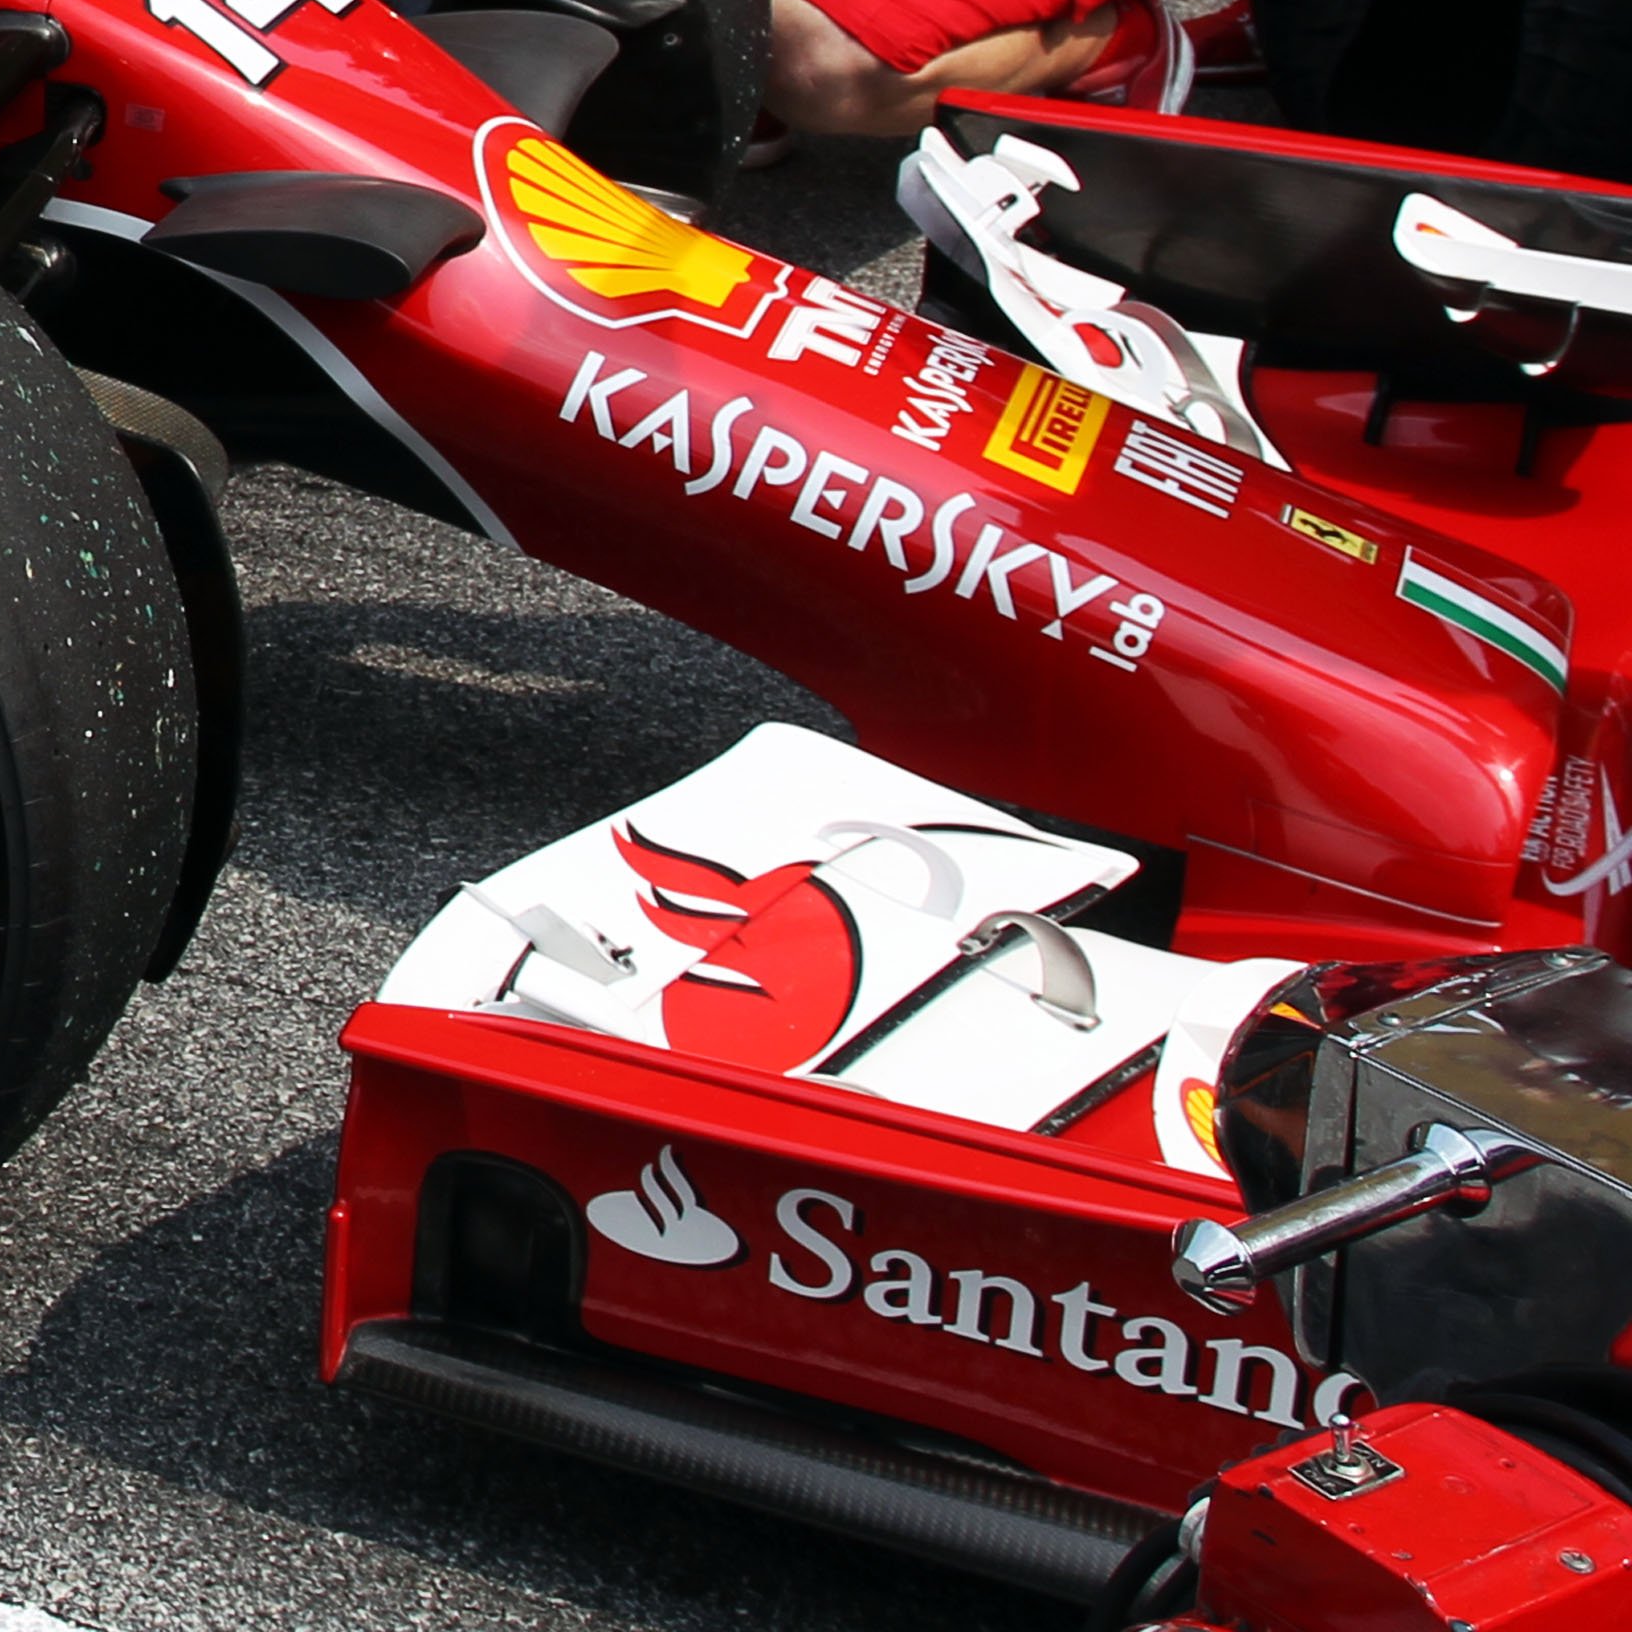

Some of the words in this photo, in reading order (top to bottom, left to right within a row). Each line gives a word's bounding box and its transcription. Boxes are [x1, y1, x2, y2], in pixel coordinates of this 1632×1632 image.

[767, 275, 887, 368] TNT
[890, 328, 996, 451] KASPERSK
[558, 352, 1122, 640] KASPERSKY
[1089, 590, 1166, 673] lab
[1113, 418, 1245, 519] FIAT
